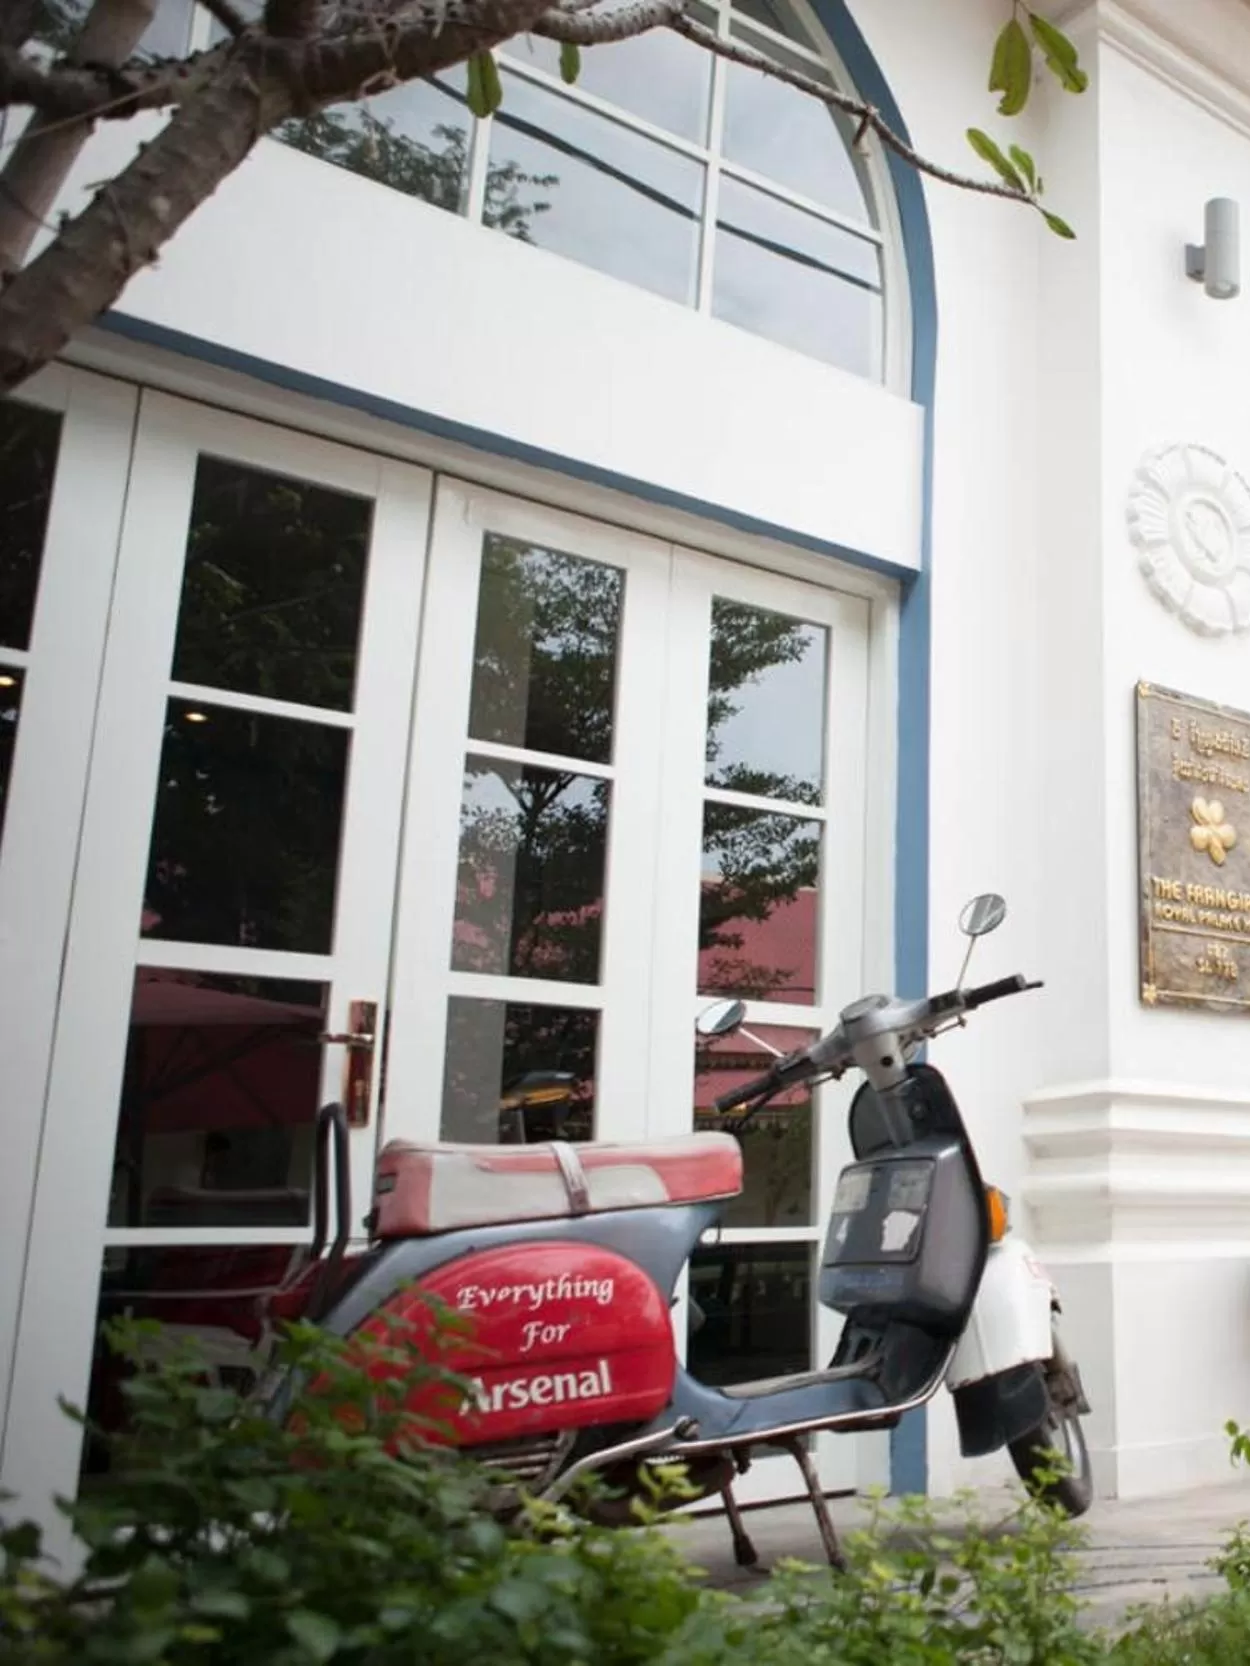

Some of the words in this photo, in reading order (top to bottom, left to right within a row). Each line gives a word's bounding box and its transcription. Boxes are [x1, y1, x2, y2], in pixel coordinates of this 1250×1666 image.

[1153, 877, 1181, 900] THE
[457, 1273, 614, 1310] Everything
[520, 1321, 570, 1352] For
[459, 1360, 612, 1416] Arsenal
